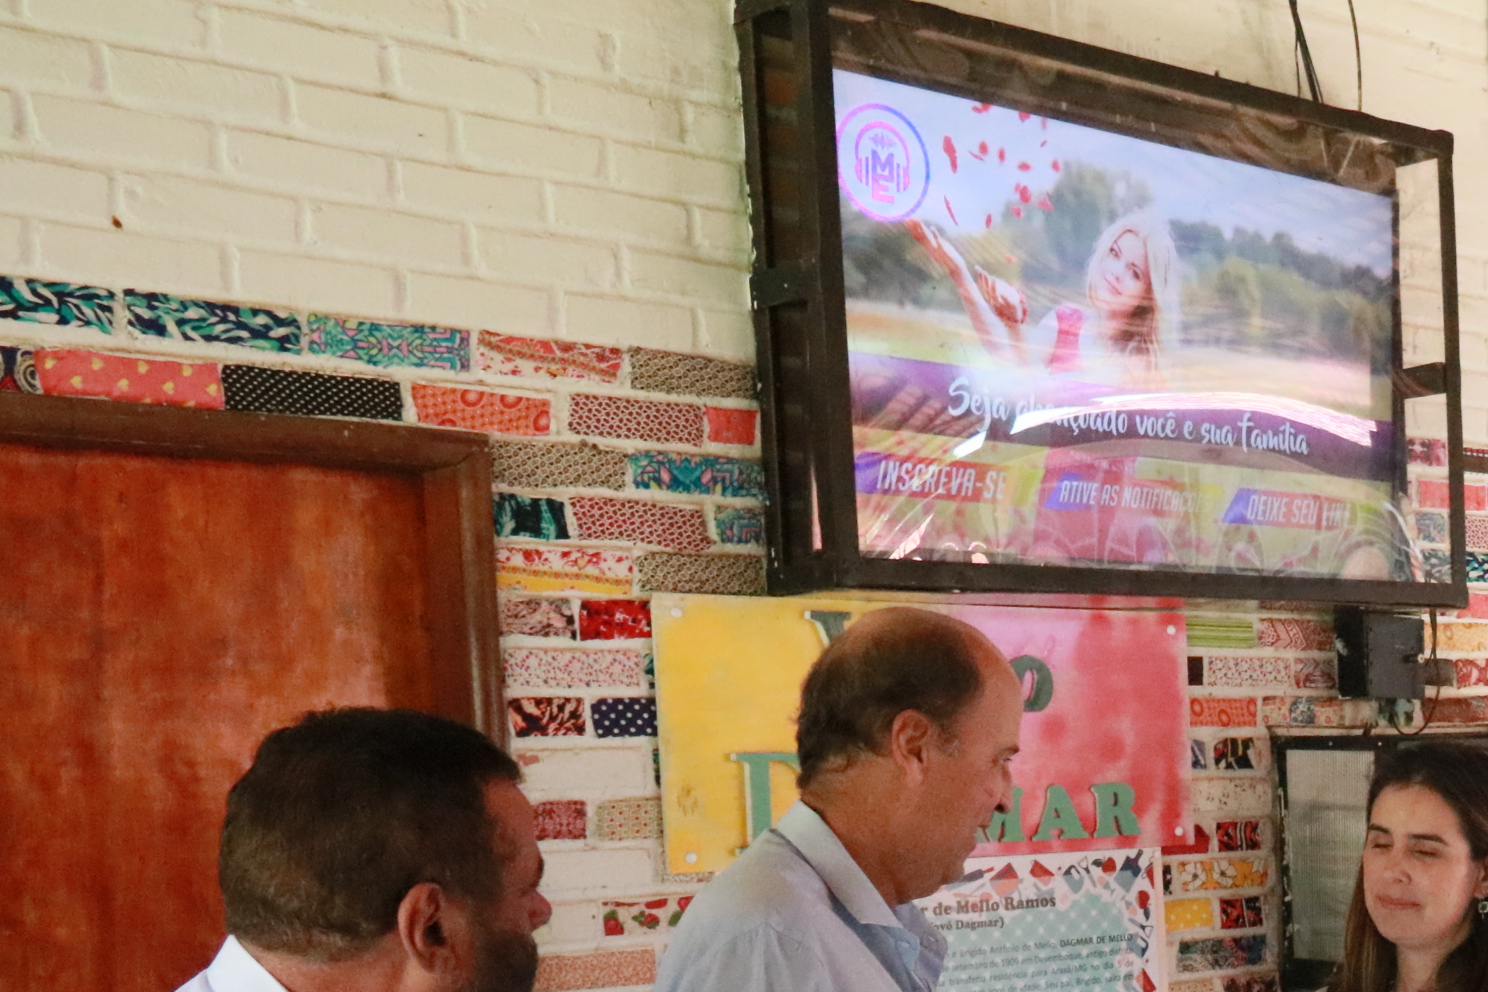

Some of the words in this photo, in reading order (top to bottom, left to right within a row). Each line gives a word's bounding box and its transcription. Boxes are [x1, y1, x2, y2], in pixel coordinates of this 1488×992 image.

[948, 377, 1010, 433] Seja
[1135, 411, 1178, 438] você
[1183, 420, 1195, 440] e
[1200, 422, 1237, 447] sua
[876, 460, 1008, 499] INSCREVA-SE
[1060, 480, 1098, 505] ATIVE
[1100, 484, 1119, 507] AS
[1246, 495, 1289, 522] DEIXE
[1291, 499, 1319, 525] SEU
[932, 902, 953, 916] de
[956, 898, 1000, 914] Mello
[1004, 896, 1057, 911] Ramos
[955, 916, 1005, 932] Dagmar)
[1059, 937, 1093, 947] DAGMAR
[1096, 936, 1105, 944] DE
[1108, 934, 1133, 942] MELLO
